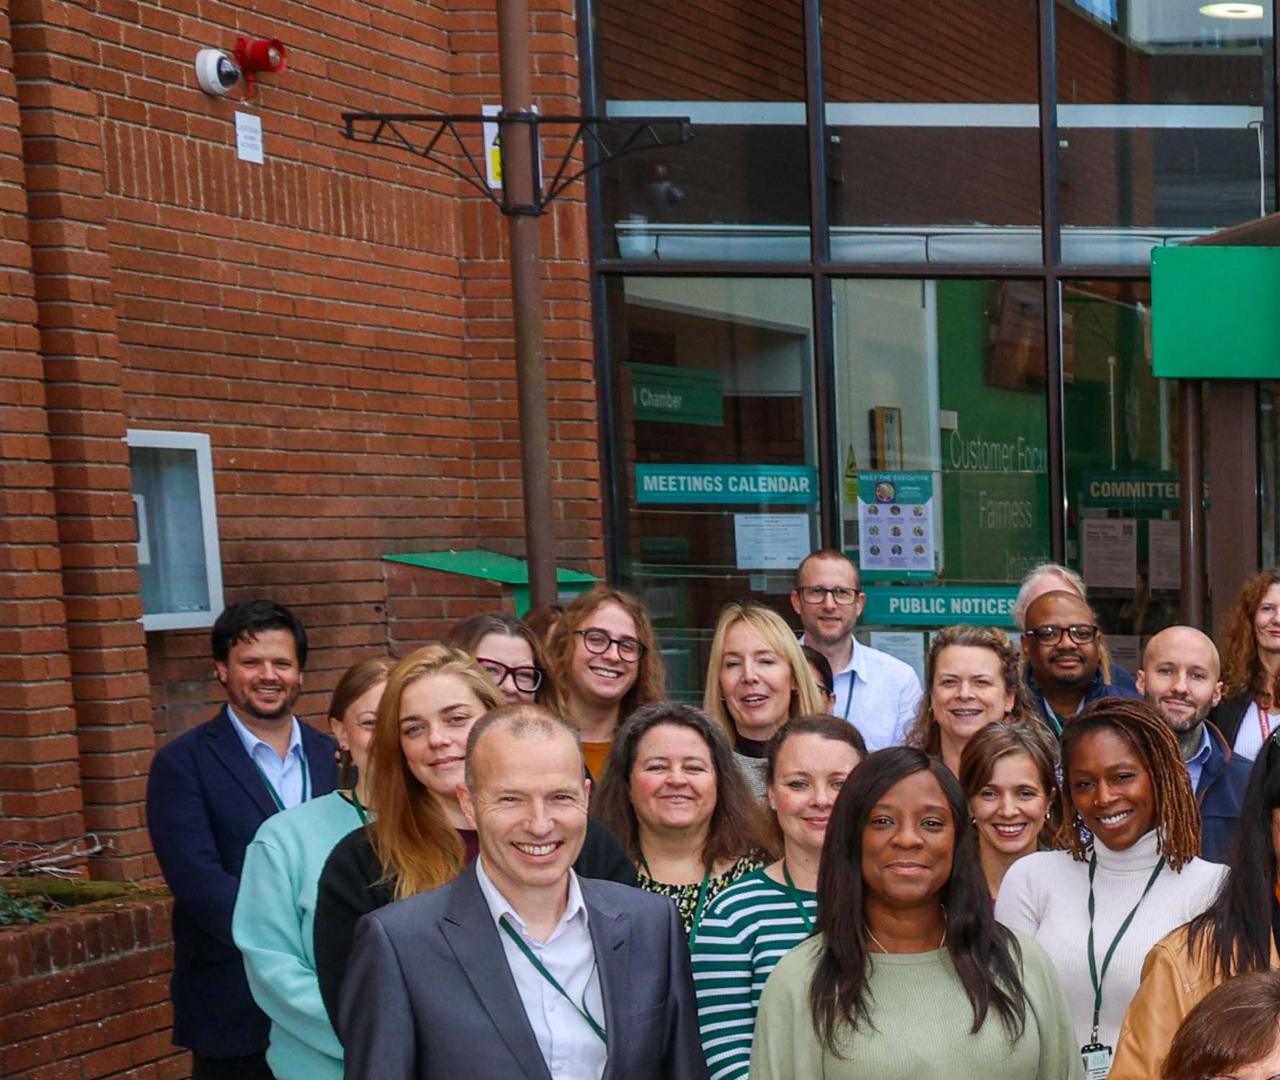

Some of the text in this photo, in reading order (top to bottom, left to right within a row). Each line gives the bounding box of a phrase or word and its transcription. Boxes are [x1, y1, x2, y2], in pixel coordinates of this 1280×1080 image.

[640, 387, 682, 409] Chamber
[949, 430, 1048, 472] Customer Focu
[642, 474, 811, 494] MEETINGS CALENDAR
[978, 490, 1033, 529] Fairness
[889, 597, 1015, 614] PUBLIC NOTICES
